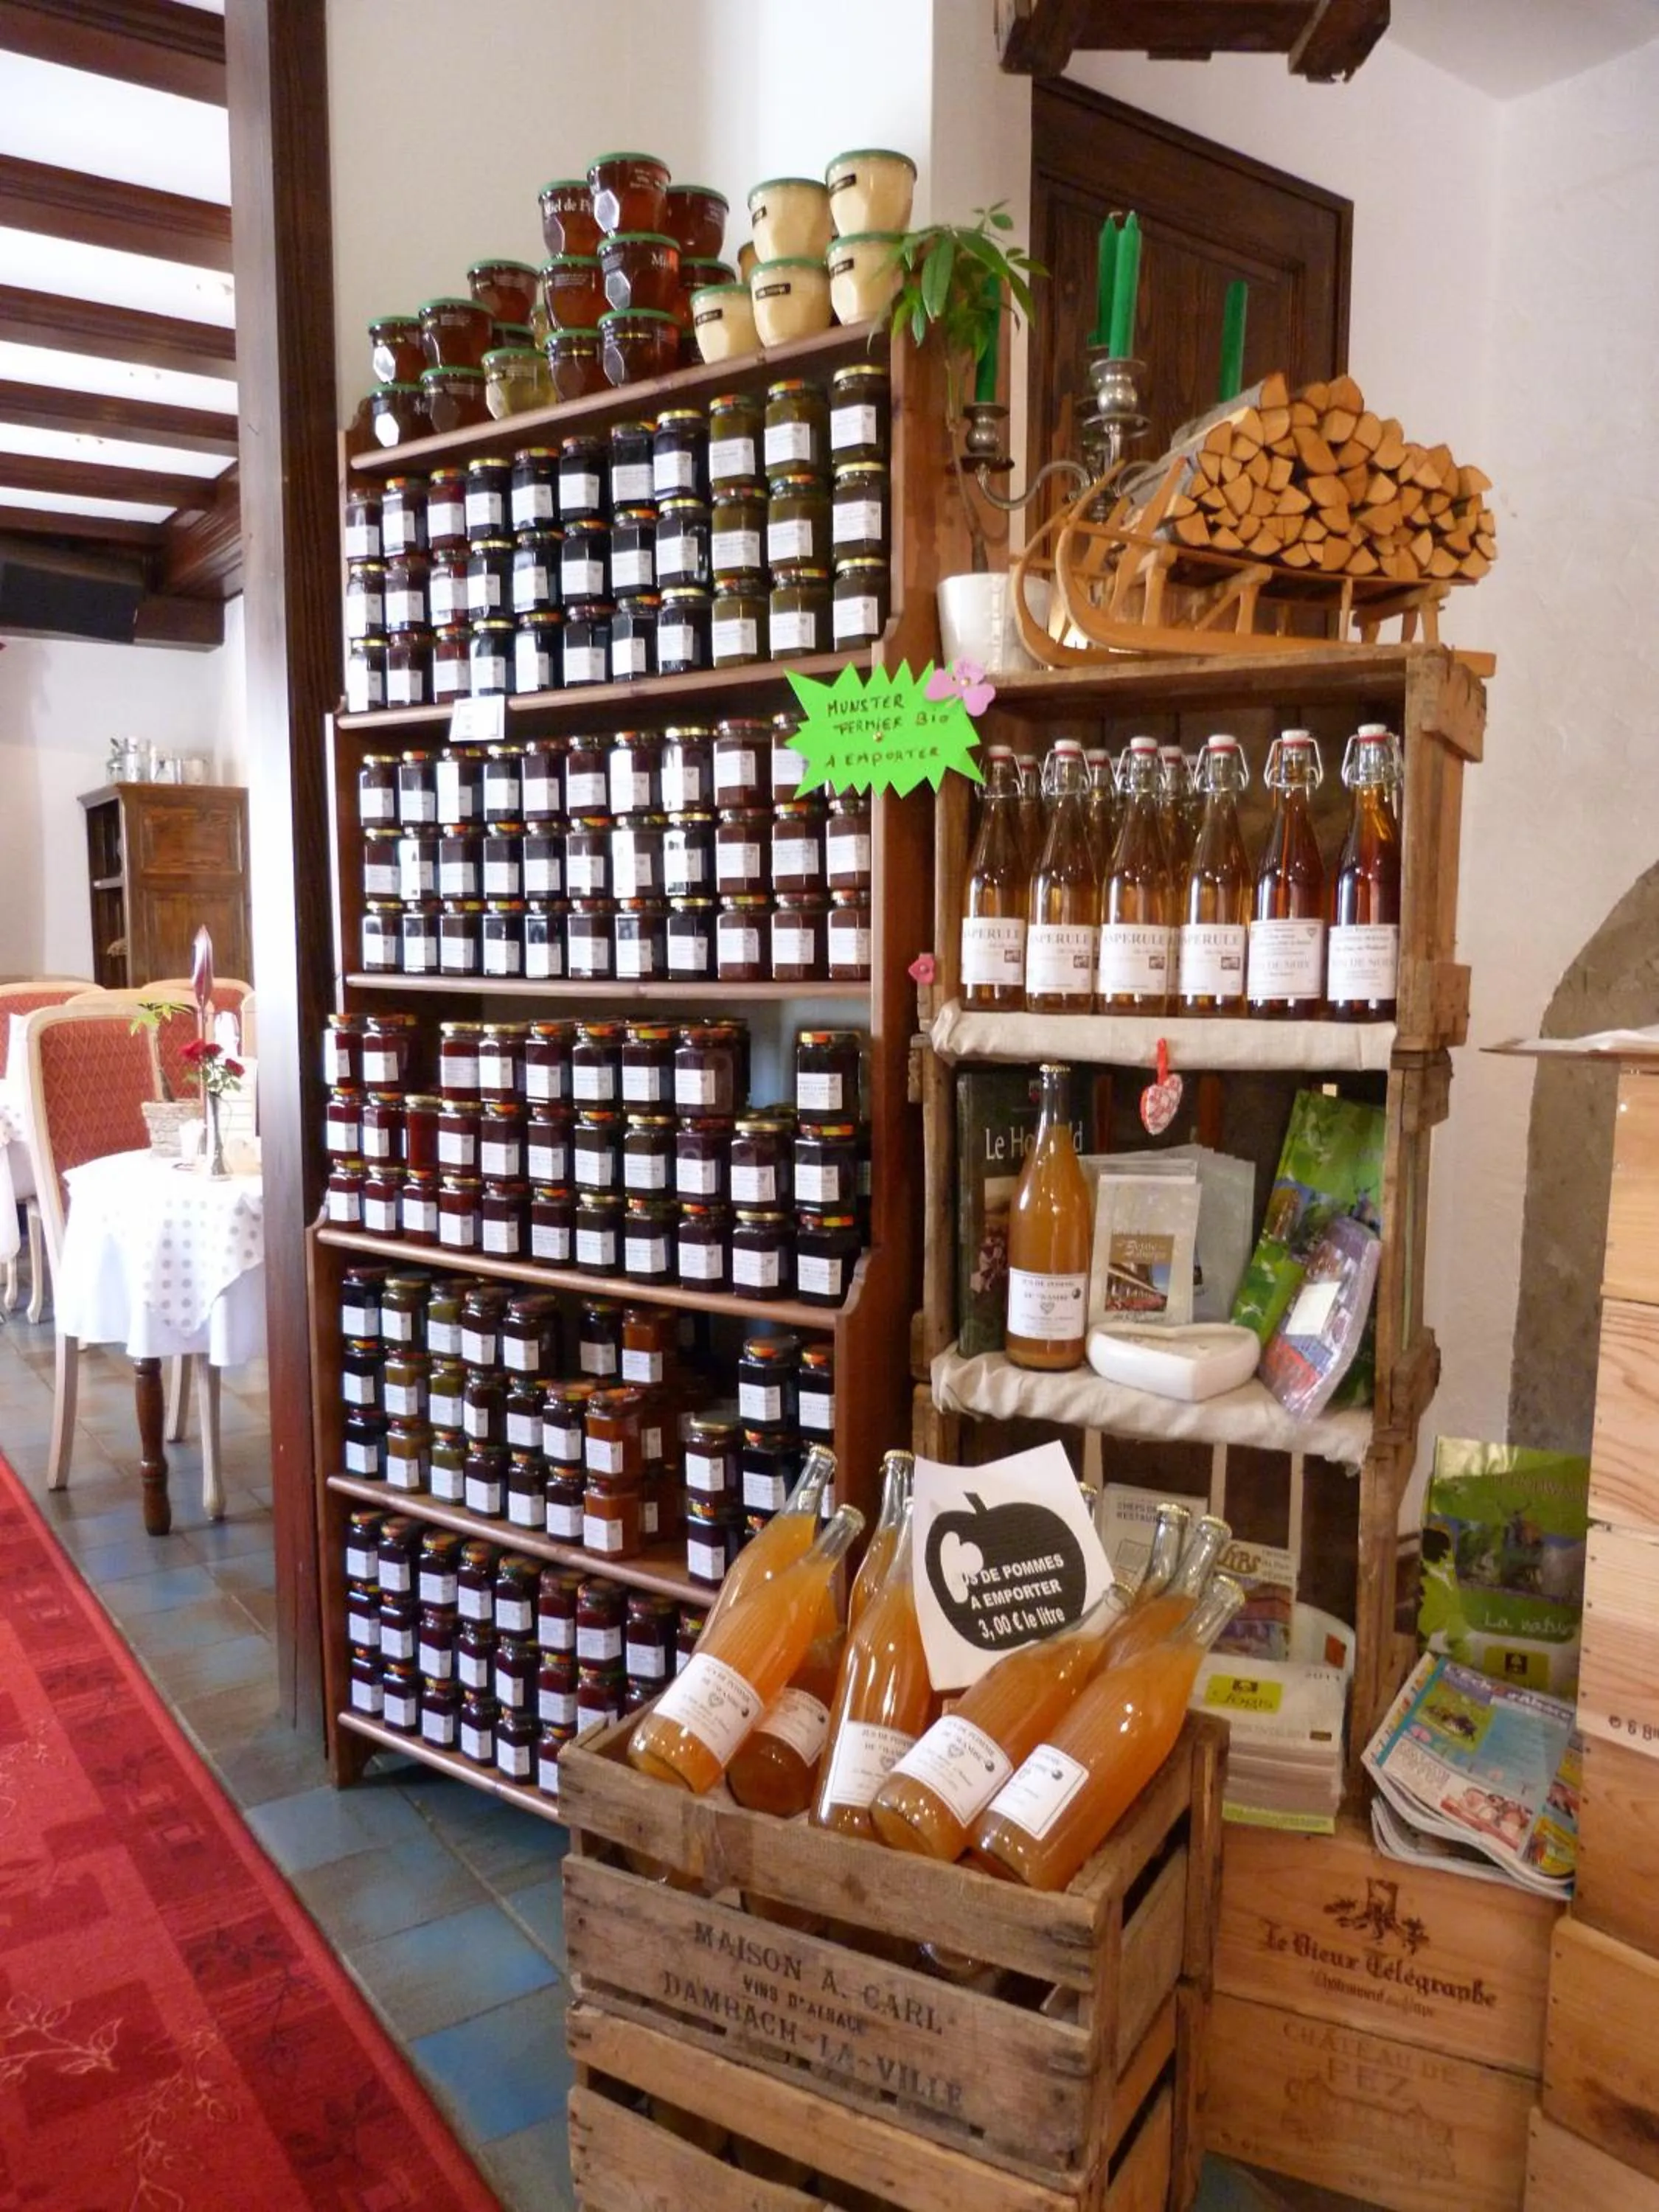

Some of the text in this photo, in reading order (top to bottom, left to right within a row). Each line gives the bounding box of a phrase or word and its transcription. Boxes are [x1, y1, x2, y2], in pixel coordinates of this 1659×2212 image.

[827, 693, 905, 717] MUNSTER
[834, 717, 903, 736] FERMIER
[825, 746, 941, 768] A EMPORTER
[985, 1127, 1005, 1161] Le
[981, 1568, 1000, 1585] DE
[1003, 1554, 1065, 1577] POMMES
[970, 1579, 1062, 1610] A EMPORTER
[1012, 1612, 1024, 1632] €
[1024, 1610, 1037, 1630] le
[1038, 1606, 1065, 1626] litre
[694, 1920, 943, 2035] MAISON A. CARL
[1259, 1918, 1497, 2008] Le Vieux Télégraphe
